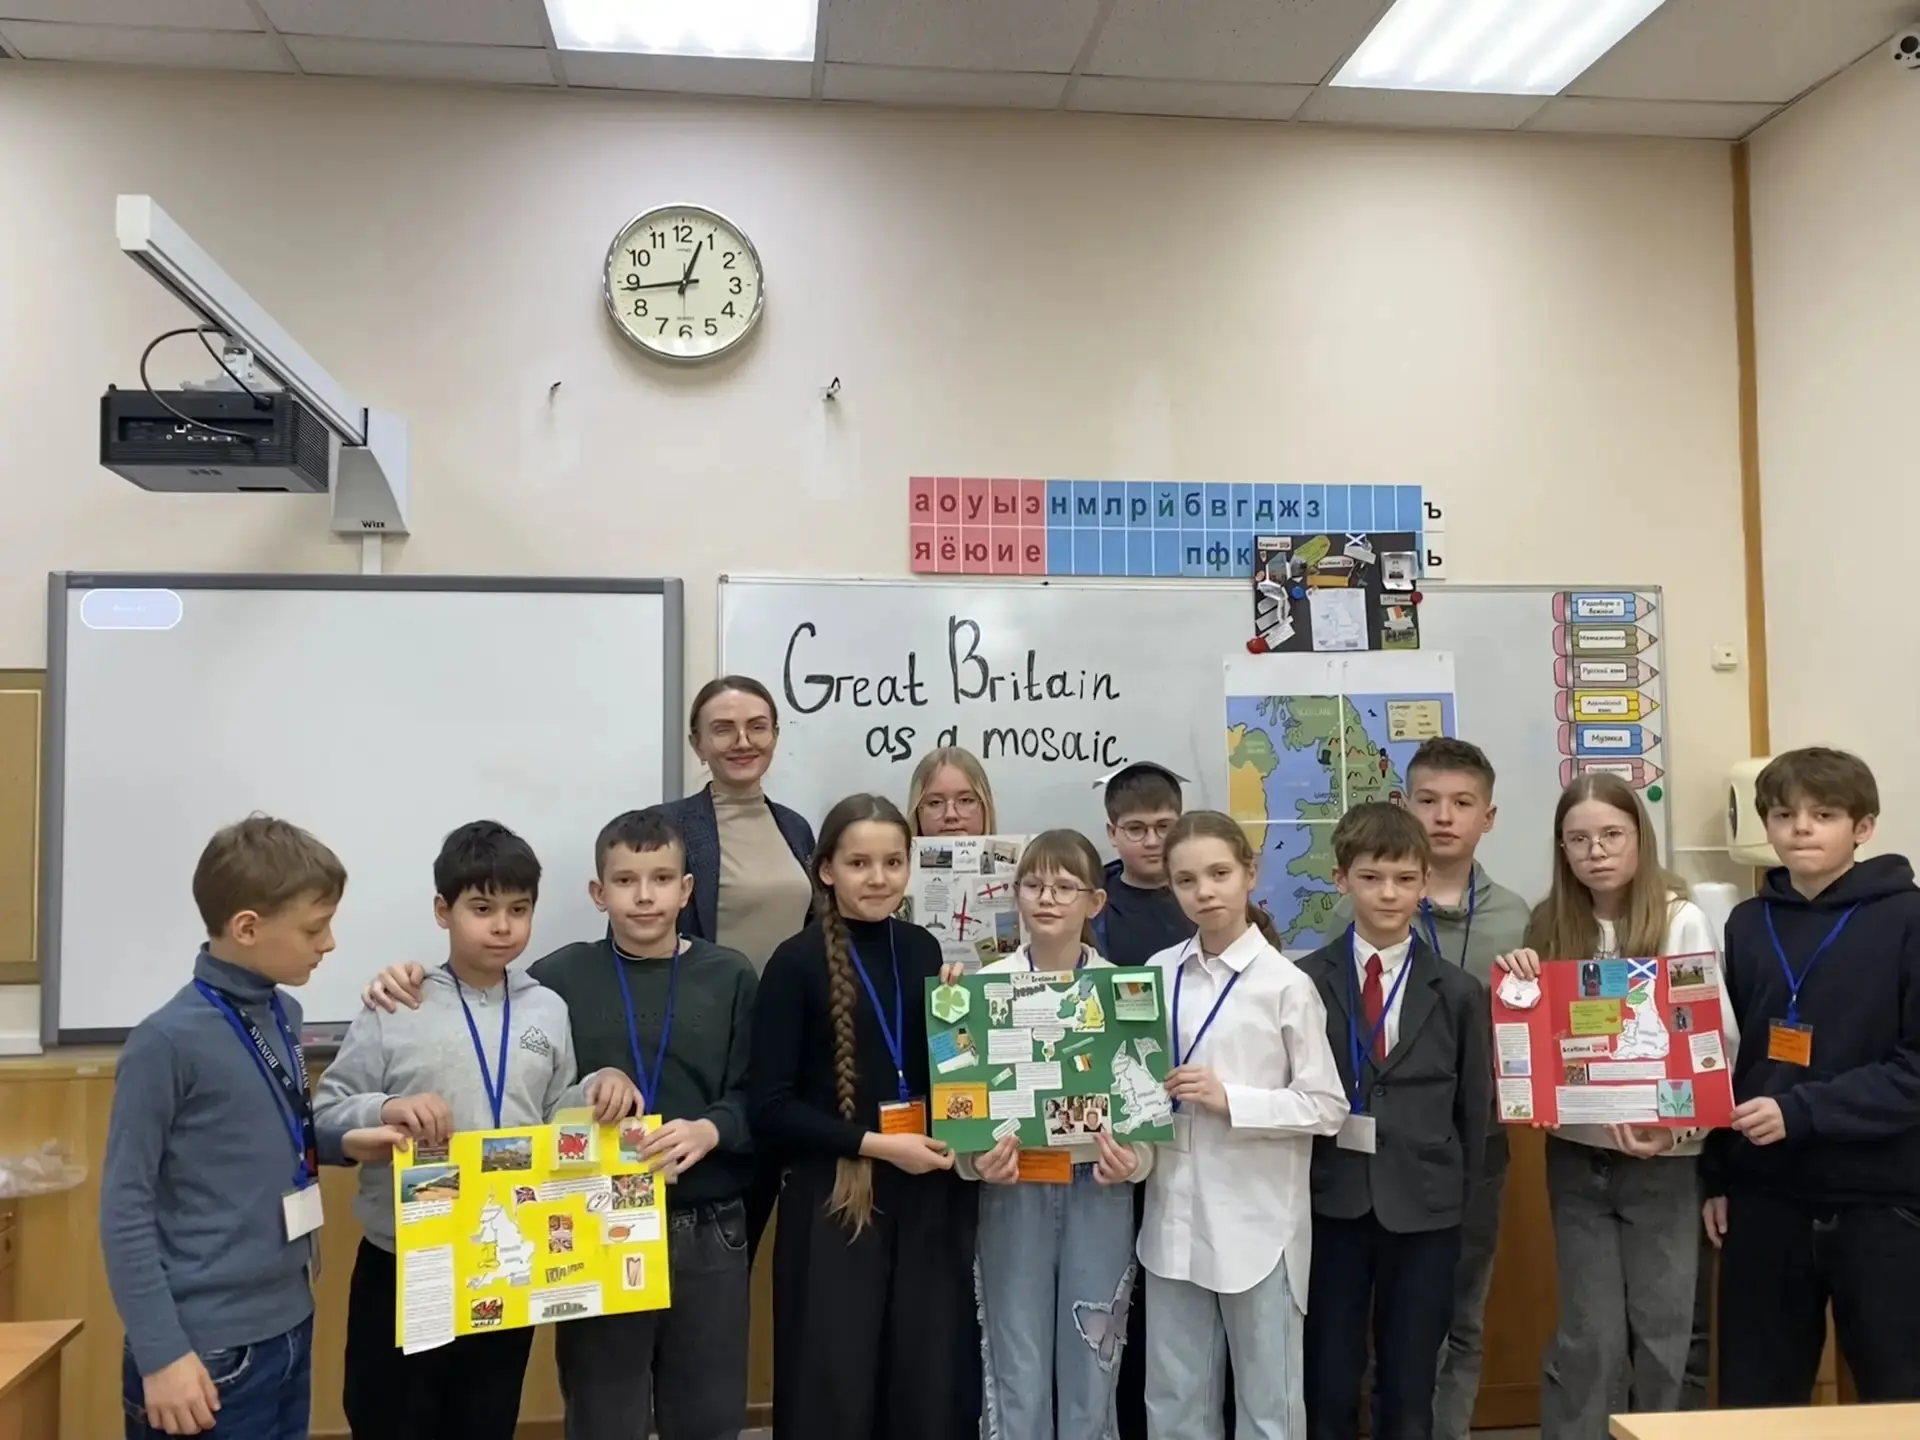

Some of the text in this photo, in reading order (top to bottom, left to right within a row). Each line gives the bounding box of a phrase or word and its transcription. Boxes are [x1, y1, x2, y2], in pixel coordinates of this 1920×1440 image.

[650, 231, 665, 249] 11
[672, 225, 693, 243] 12
[706, 233, 714, 250] 1
[629, 249, 651, 267] 10
[722, 252, 736, 269] 2
[626, 273, 641, 291] 9
[729, 277, 742, 295] 3
[634, 299, 648, 317] 8
[721, 301, 736, 318] 4
[655, 317, 669, 335] 7
[679, 324, 693, 341] 6
[704, 318, 718, 336] 5
[914, 493, 930, 512] а
[940, 493, 957, 512] о
[967, 493, 983, 520] у
[994, 495, 1016, 514] ы
[1026, 496, 1040, 515] э
[1051, 496, 1067, 515] н
[1078, 497, 1096, 515] м
[1104, 497, 1121, 516] л
[1131, 497, 1147, 521] р
[1158, 492, 1174, 517] й
[1184, 492, 1201, 517] б
[1211, 499, 1227, 517] в
[1237, 499, 1248, 517] г
[1255, 499, 1274, 521] д
[1279, 499, 1299, 517] ж
[1307, 499, 1320, 517] з
[914, 541, 931, 560] я
[940, 536, 956, 561] ё
[965, 542, 988, 561] ю
[998, 543, 1013, 562] и
[1026, 544, 1041, 562] е
[1186, 547, 1201, 565] п
[1206, 541, 1230, 571] ф
[1237, 547, 1251, 565] к
[783, 615, 1120, 714] Great Britain
[866, 724, 1128, 768] as a mosaic.
[1591, 735, 1623, 744] Музыка
[1031, 975, 1057, 983] Ireland
[293, 1044, 310, 1089] IRONMAN
